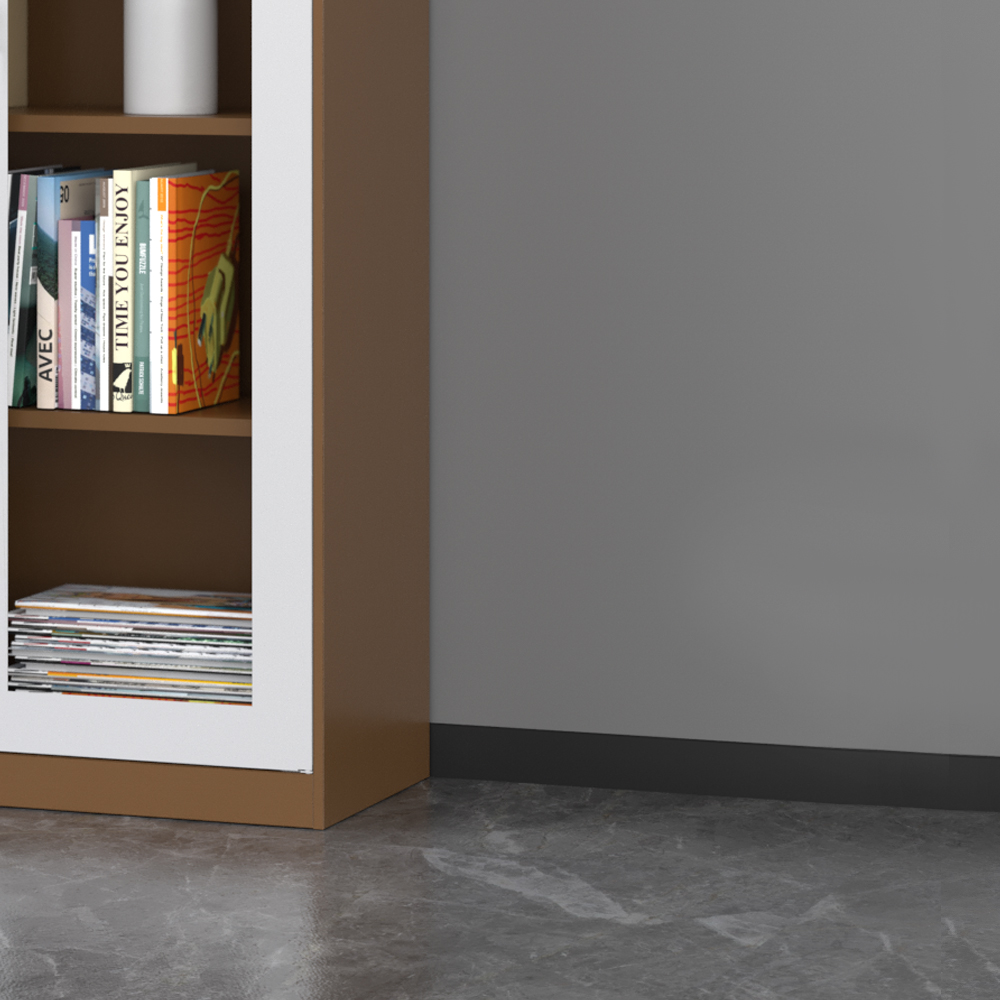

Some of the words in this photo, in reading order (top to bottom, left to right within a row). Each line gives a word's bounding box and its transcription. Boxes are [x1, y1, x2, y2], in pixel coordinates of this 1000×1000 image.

[115, 184, 129, 247] ENJOY
[115, 257, 129, 295] YOU
[115, 300, 129, 351] TIME
[38, 329, 53, 382] AVEC
